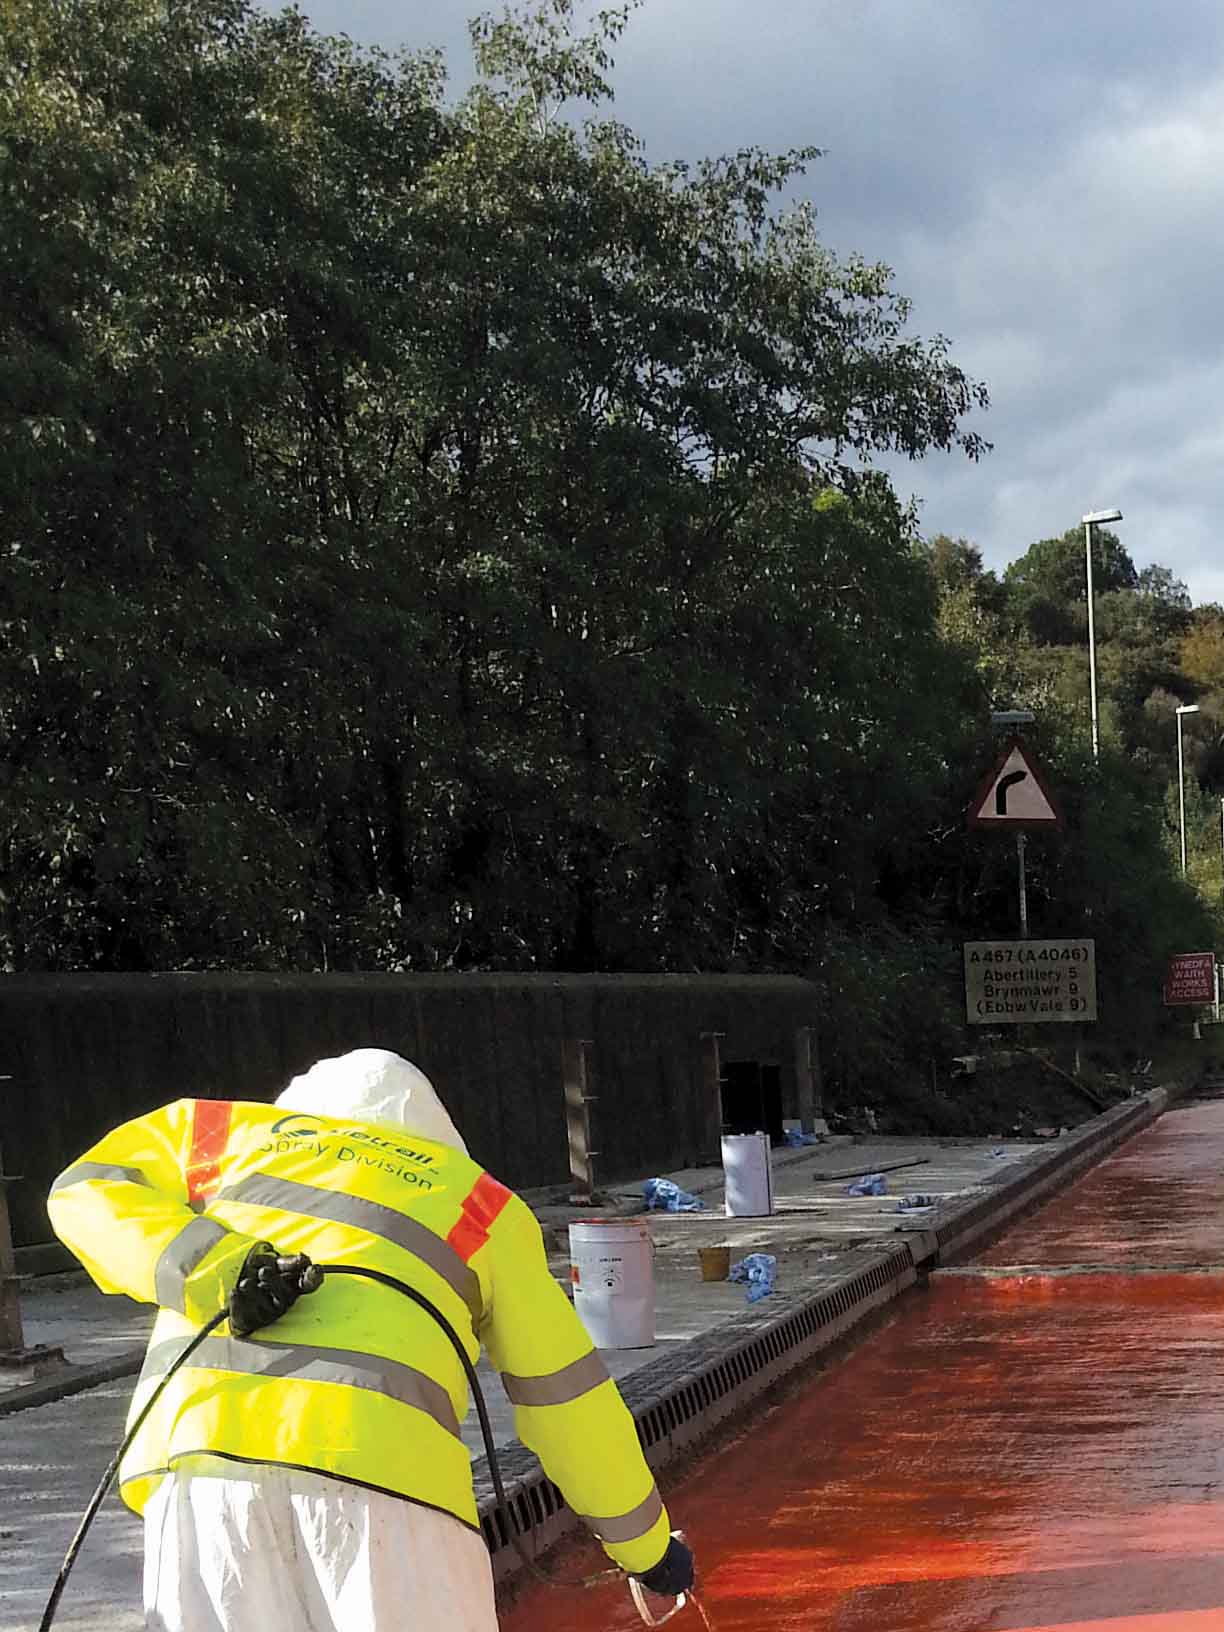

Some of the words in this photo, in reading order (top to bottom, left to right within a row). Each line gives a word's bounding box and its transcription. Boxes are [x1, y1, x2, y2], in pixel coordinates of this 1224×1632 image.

[969, 949, 1012, 963] A467
[1017, 947, 1088, 964] (A4046)
[983, 968, 1061, 982] Abertillery
[1068, 967, 1078, 979] 5
[983, 984, 1060, 998] Brynmawr
[336, 1146, 433, 1191] Division
